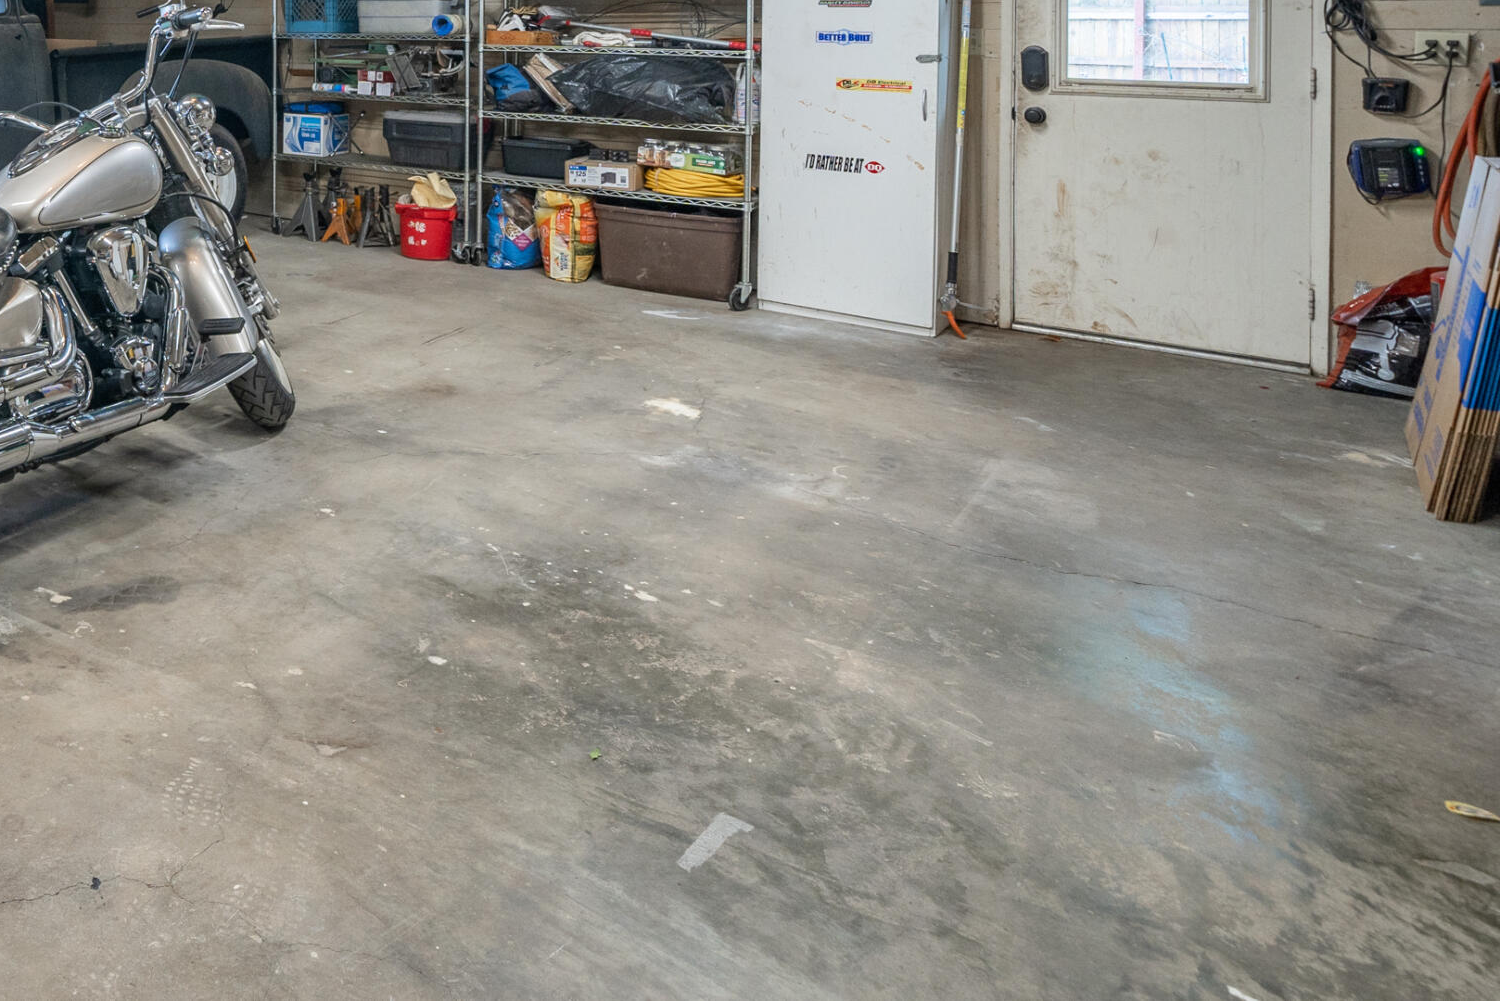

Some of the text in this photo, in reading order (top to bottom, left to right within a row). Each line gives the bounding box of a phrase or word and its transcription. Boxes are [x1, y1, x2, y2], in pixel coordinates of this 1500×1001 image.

[818, 33, 871, 41] BETTER BUILT
[805, 154, 815, 168] I'D
[815, 155, 843, 171] RATHER
[843, 157, 854, 172] BE
[854, 158, 865, 173] AT
